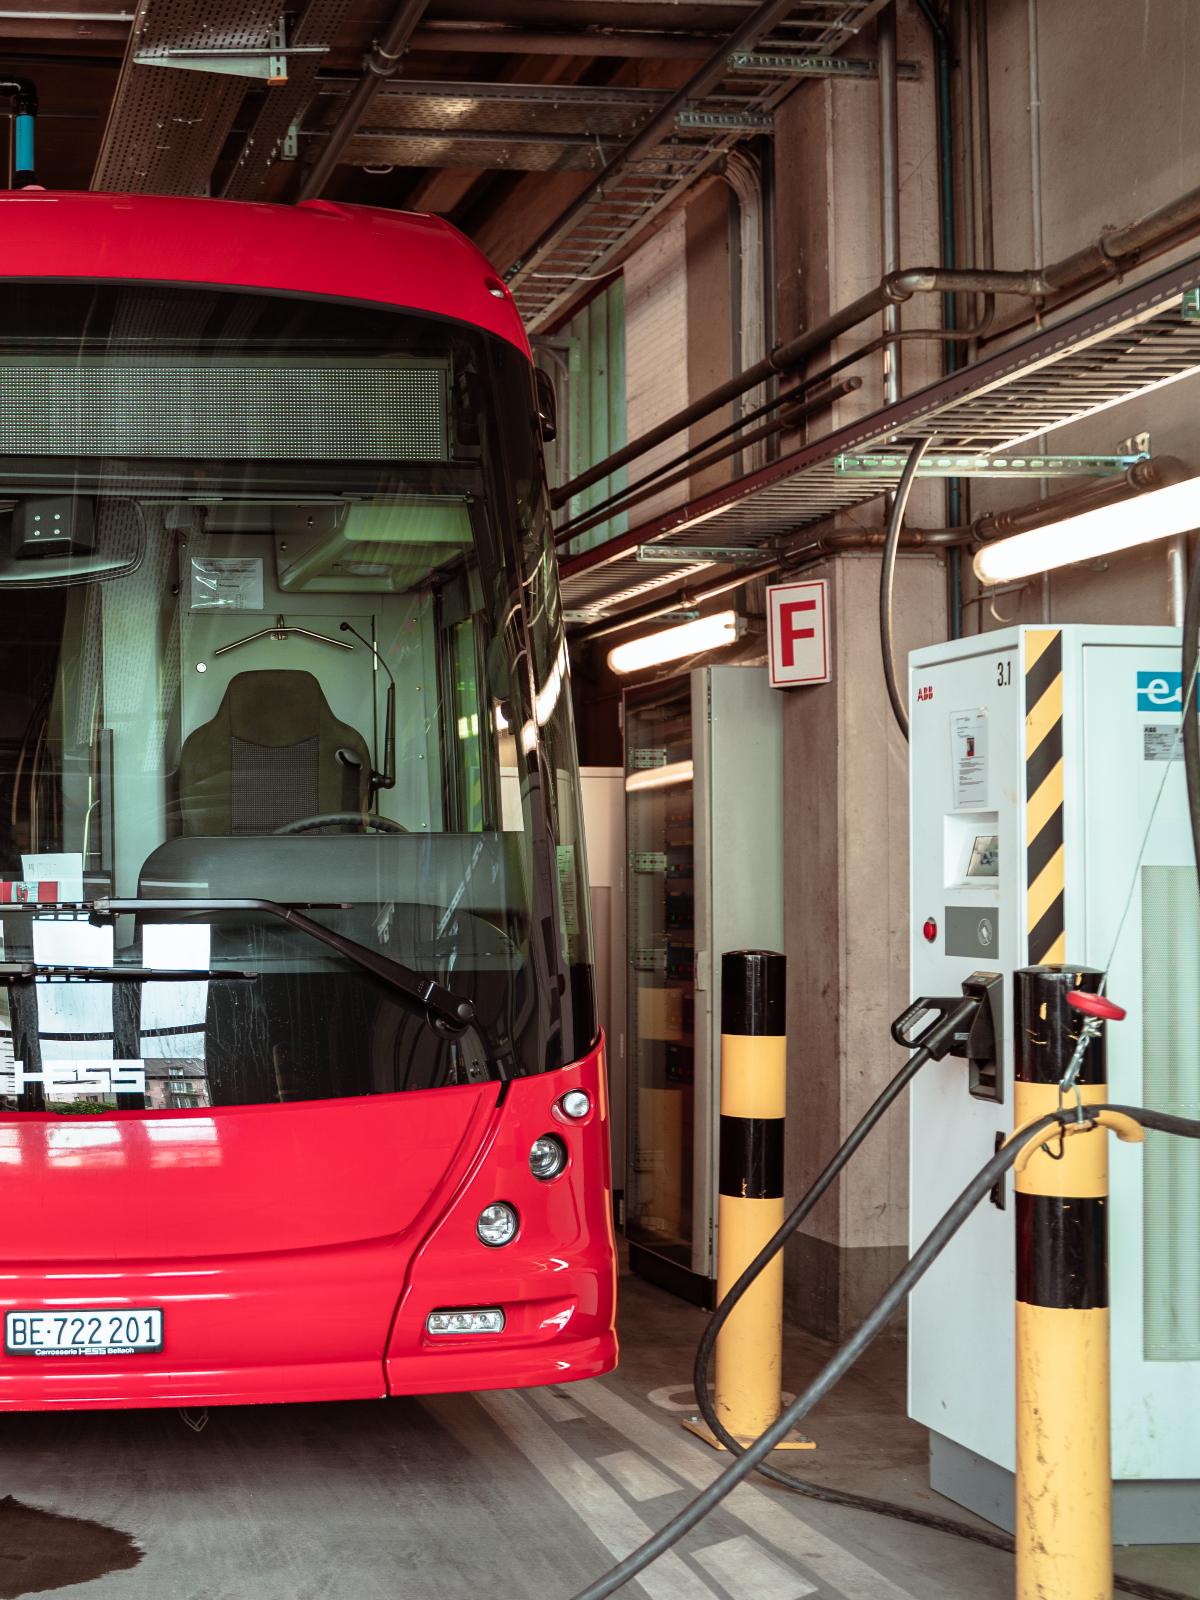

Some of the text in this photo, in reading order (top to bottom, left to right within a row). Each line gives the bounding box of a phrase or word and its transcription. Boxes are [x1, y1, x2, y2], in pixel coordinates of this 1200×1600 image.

[779, 599, 817, 668] F
[997, 660, 1012, 687] 3.1
[916, 685, 934, 702] ABB
[14, 1059, 146, 1095] HESS
[34, 1346, 135, 1356] Carrosserie HESS Bellach
